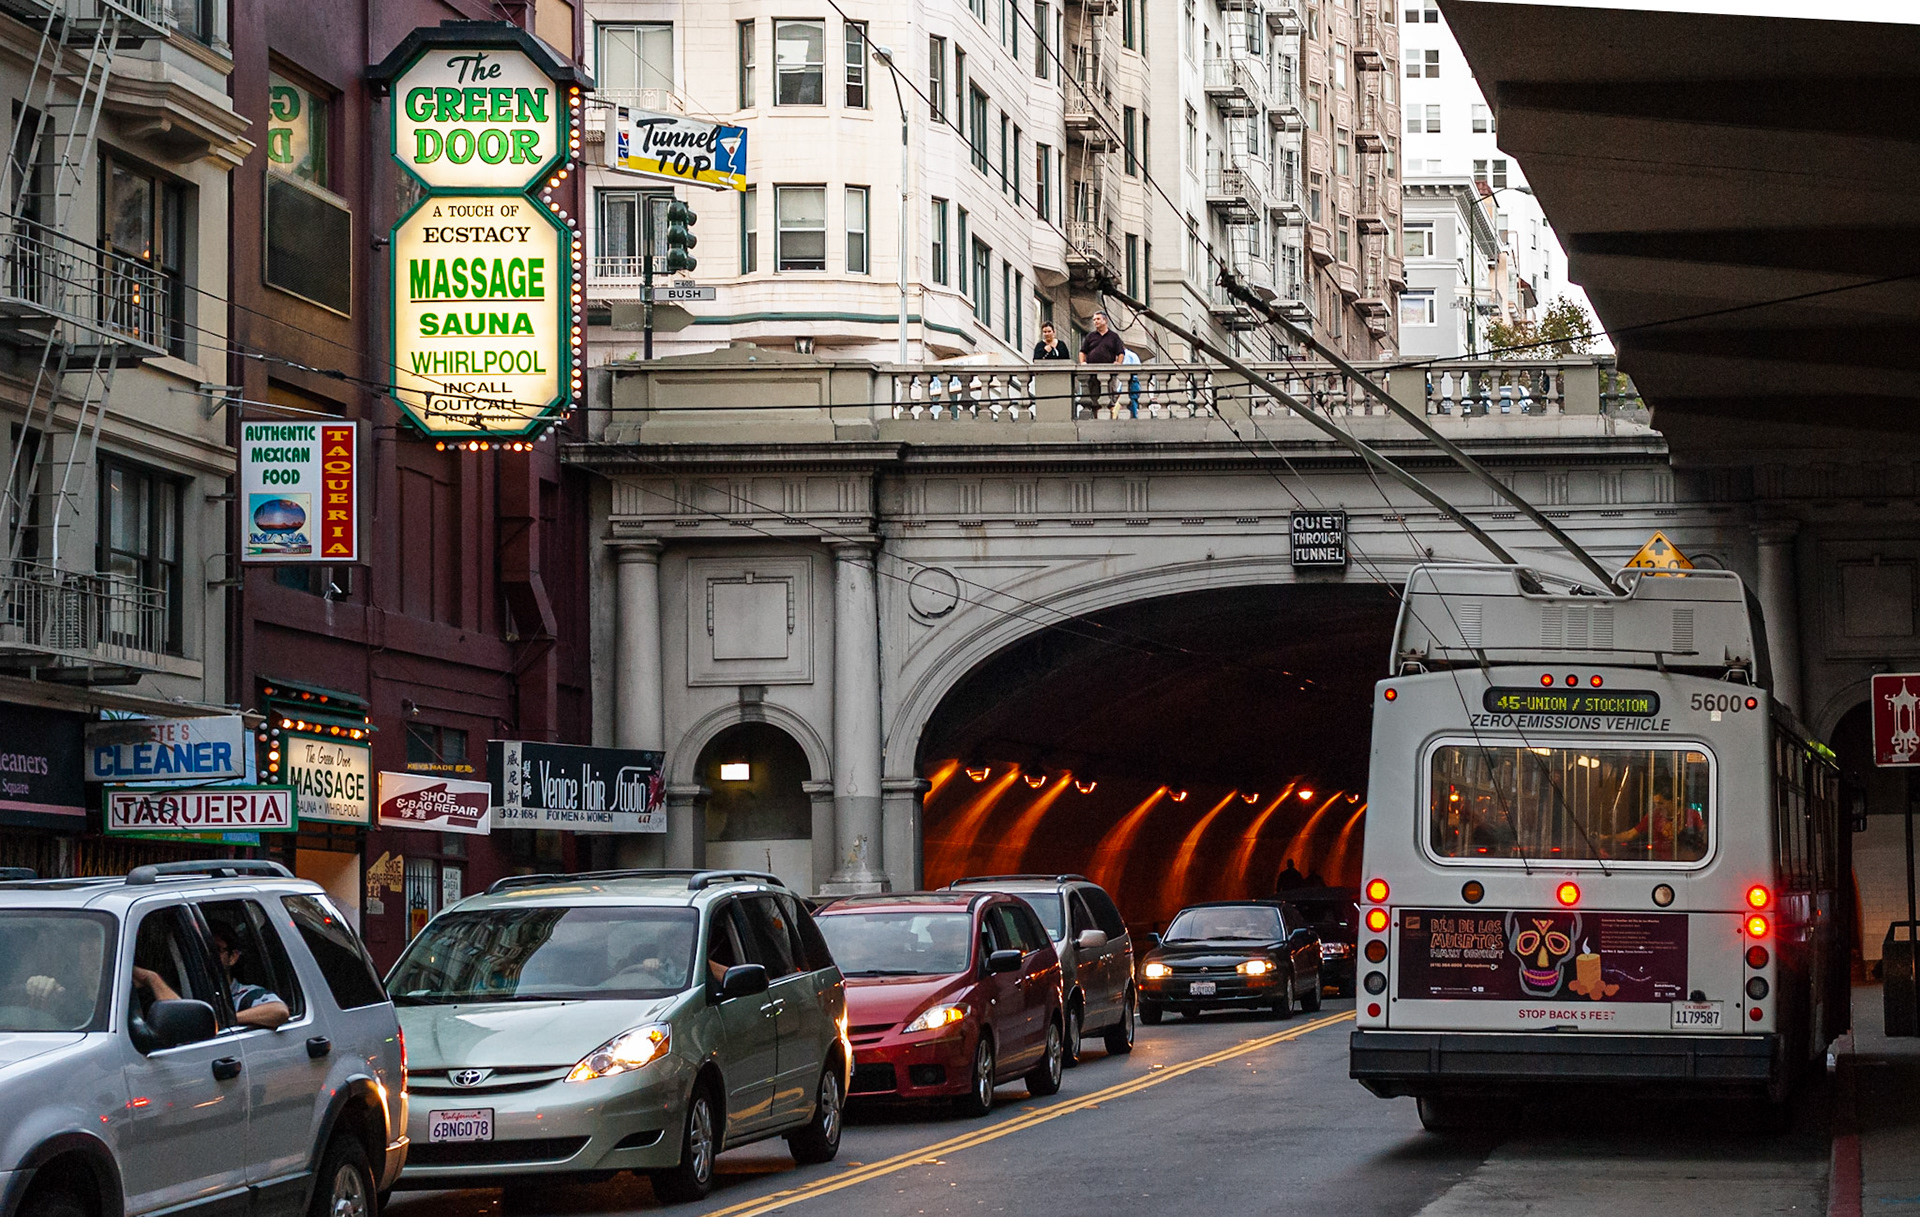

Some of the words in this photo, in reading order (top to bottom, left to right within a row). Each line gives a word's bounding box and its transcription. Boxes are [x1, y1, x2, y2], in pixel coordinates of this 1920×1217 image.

[447, 52, 502, 84] The
[405, 87, 549, 122] GREEN
[636, 118, 722, 153] Tunnel
[414, 129, 542, 165] DOOR
[655, 150, 712, 179] TOP
[433, 205, 442, 217] A
[448, 205, 494, 217] TOUCH
[500, 205, 519, 217] OF
[423, 227, 531, 243] ECSTACY
[410, 257, 545, 299] MASSAGE
[668, 290, 701, 298] BUSH
[420, 312, 534, 336] SAUNA
[411, 350, 546, 374] WHIRLPOOL
[443, 382, 513, 393] INCALL
[434, 399, 523, 411] OUTCALL
[245, 426, 316, 441] AUTHENTIC
[252, 447, 310, 462] MEXICAN
[263, 469, 301, 485] FOOD
[324, 430, 351, 554] TAQUERIA
[1294, 516, 1342, 530] QUIET
[1294, 532, 1342, 544] THROUGH
[1294, 548, 1343, 560] TUNNEL
[1497, 696, 1567, 711] 45-UNION
[1585, 698, 1648, 713] STOCKTON
[1691, 694, 1742, 713] 5600
[1471, 713, 1514, 728] ZERO
[1517, 715, 1602, 730] EMISSIONS
[1606, 717, 1671, 731] VEHICLE
[94, 742, 233, 777] CLEANER
[305, 744, 315, 764] The
[318, 746, 335, 765] Green
[337, 747, 351, 767] Door
[290, 766, 365, 801] MASSAGE
[507, 749, 520, 806] 威尼斯
[2, 778, 29, 796] Square
[539, 760, 578, 810] Venice
[610, 766, 652, 813] Studio
[420, 791, 457, 804] SHOE
[116, 795, 284, 827] TAQUERIA
[324, 803, 360, 818] WHIRLPOOL
[396, 798, 408, 809] &
[408, 800, 433, 811] BAG
[434, 803, 479, 816] REPAIR
[499, 808, 538, 820] 392-1684
[561, 811, 579, 822] MEN
[580, 813, 585, 821] &
[587, 812, 613, 823] WOMEN
[1458, 919, 1474, 933] DE
[1478, 920, 1502, 934] LOS
[1430, 933, 1504, 949] MUERTOS
[1518, 1009, 1546, 1019] STOP
[1549, 1010, 1578, 1020] BACK
[1580, 1011, 1587, 1020] 5
[1675, 1011, 1720, 1024] 1179587
[442, 1112, 479, 1121] California
[433, 1120, 489, 1137] 6BNG078
